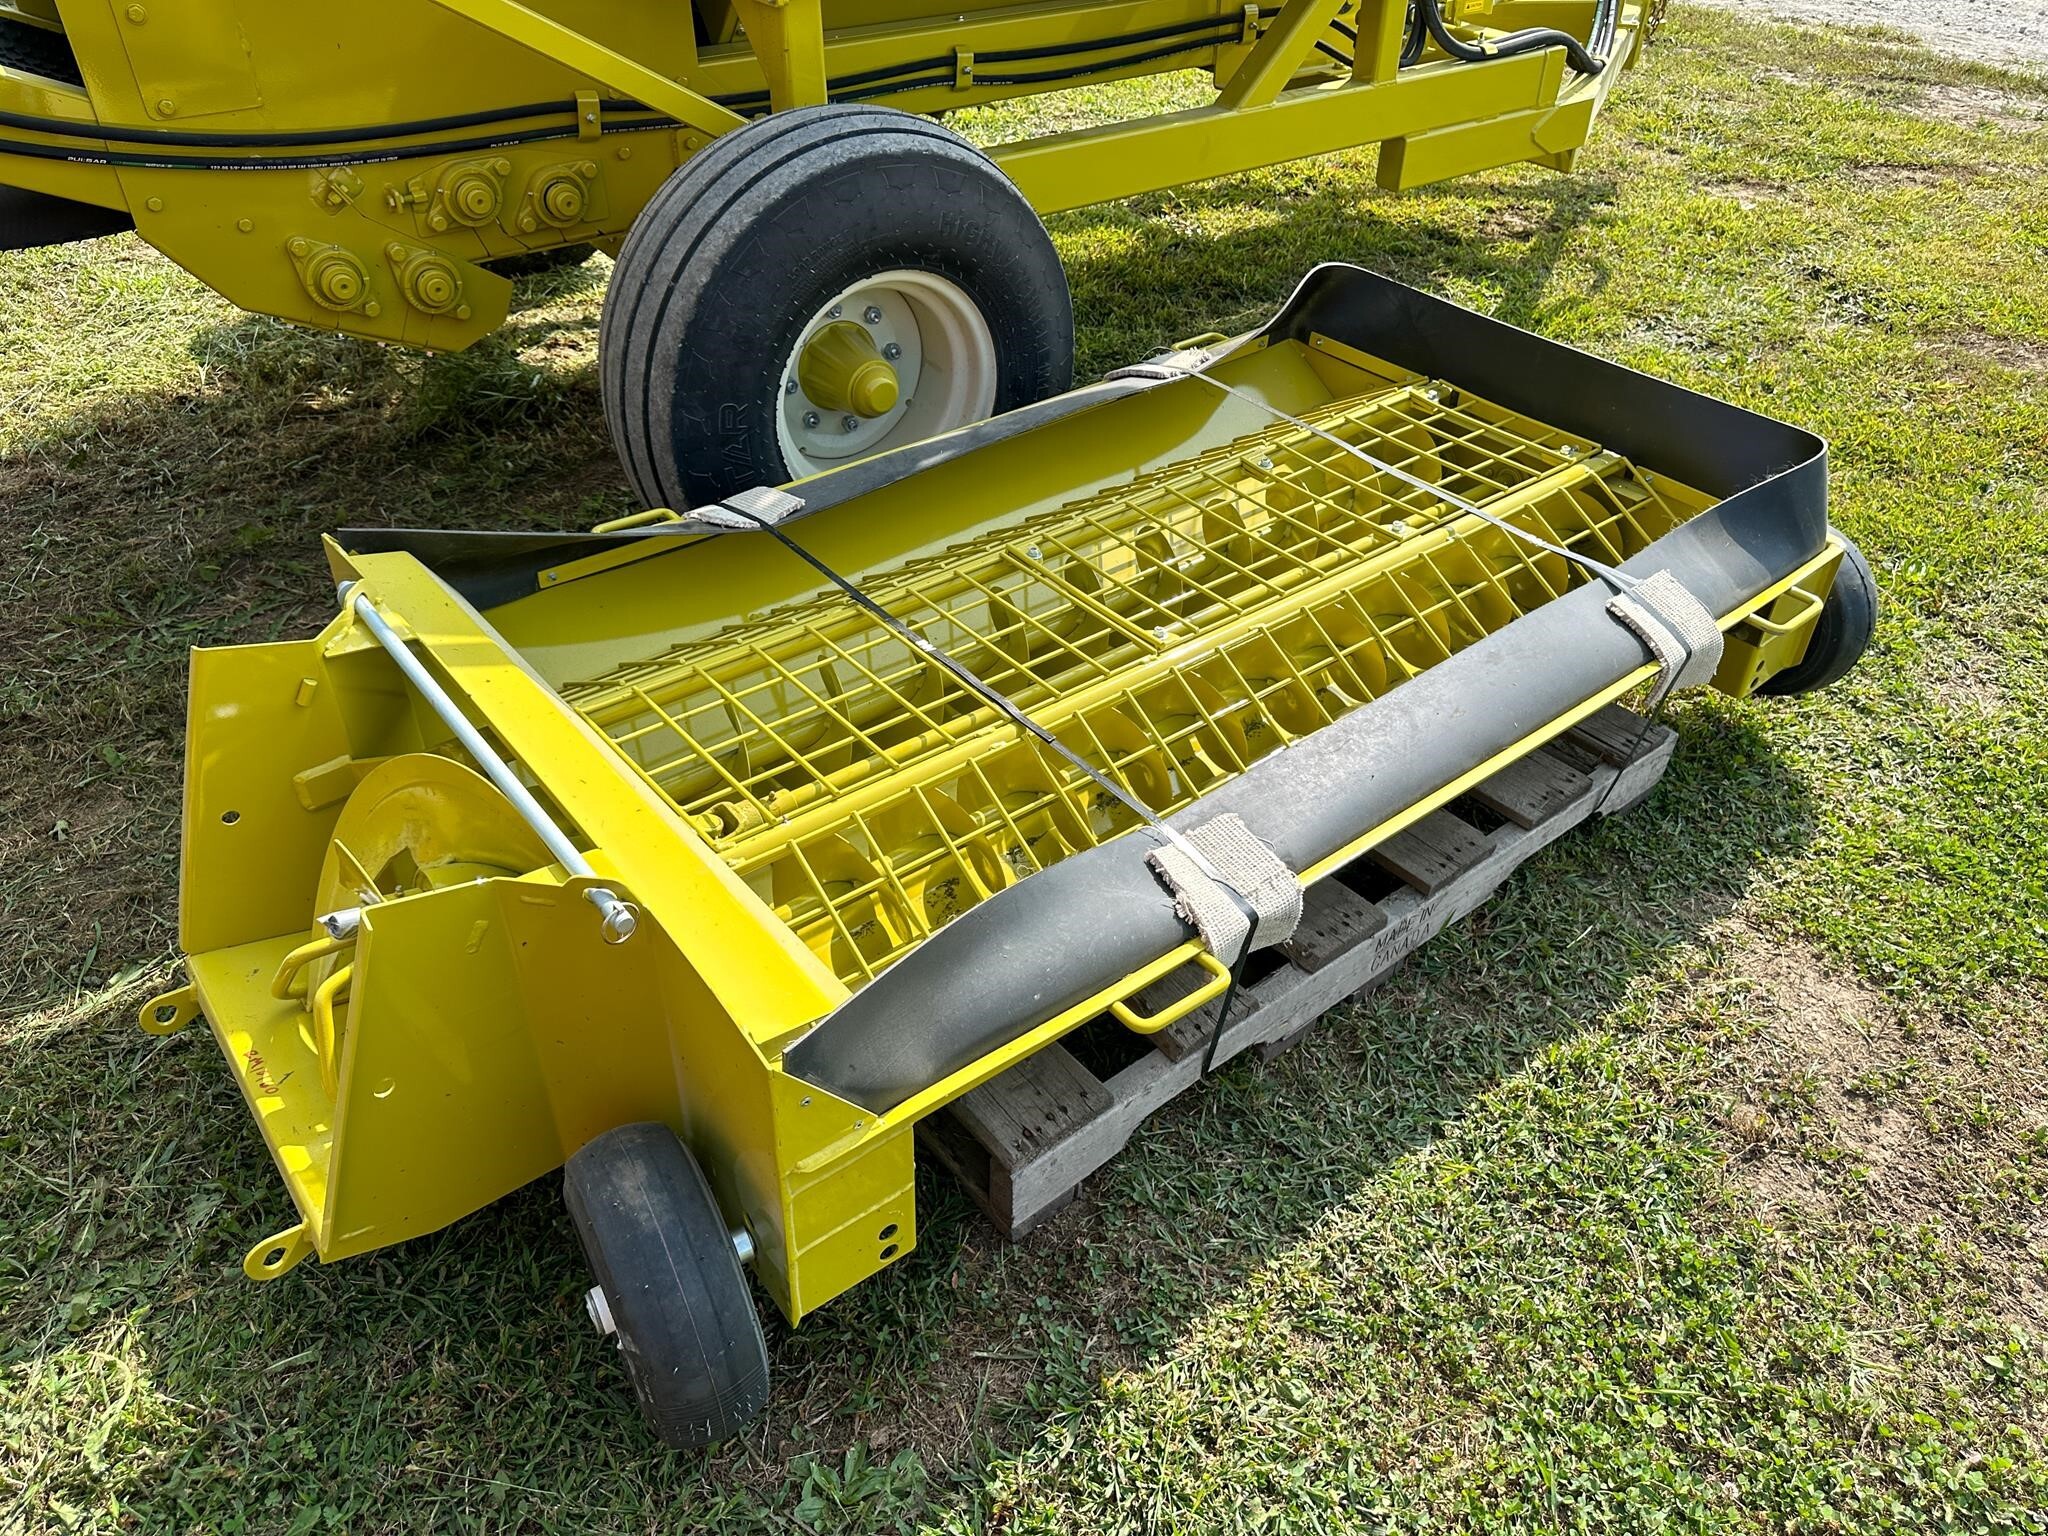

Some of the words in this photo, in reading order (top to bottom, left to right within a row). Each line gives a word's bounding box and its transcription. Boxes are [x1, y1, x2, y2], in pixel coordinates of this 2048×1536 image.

[67, 156, 107, 165] PULSAR
[1370, 923, 1430, 972] CANADA
[1375, 914, 1419, 953] MADE
[1420, 903, 1436, 923] IN
